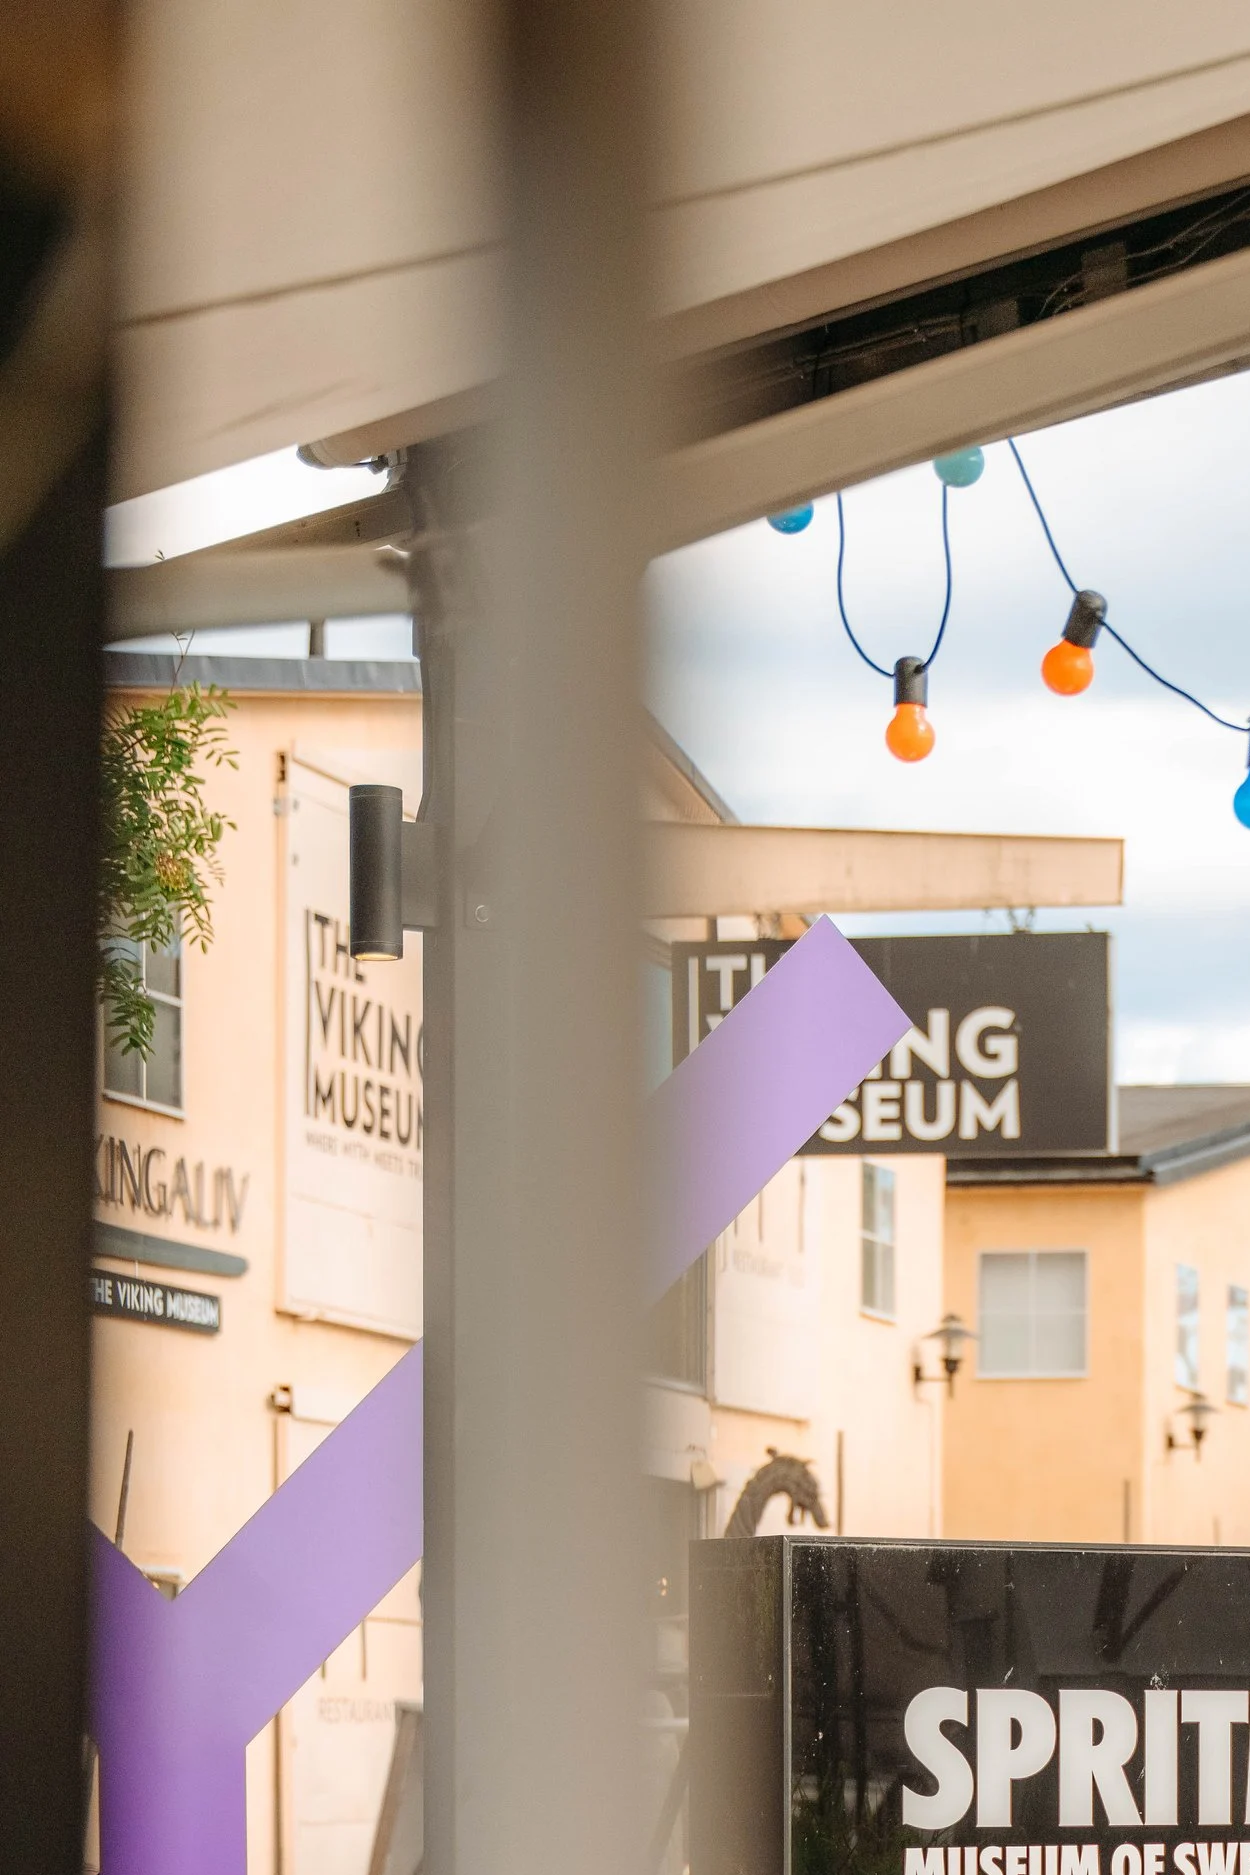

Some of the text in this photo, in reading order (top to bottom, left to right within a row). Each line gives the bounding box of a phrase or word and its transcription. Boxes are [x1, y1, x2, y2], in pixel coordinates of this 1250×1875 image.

[817, 1078, 1022, 1142] SEUM
[97, 1133, 250, 1234] INGALIV
[117, 1280, 164, 1316] VIKING
[166, 1291, 220, 1328] MUSEUM
[317, 1696, 395, 1723] RESTAURAN
